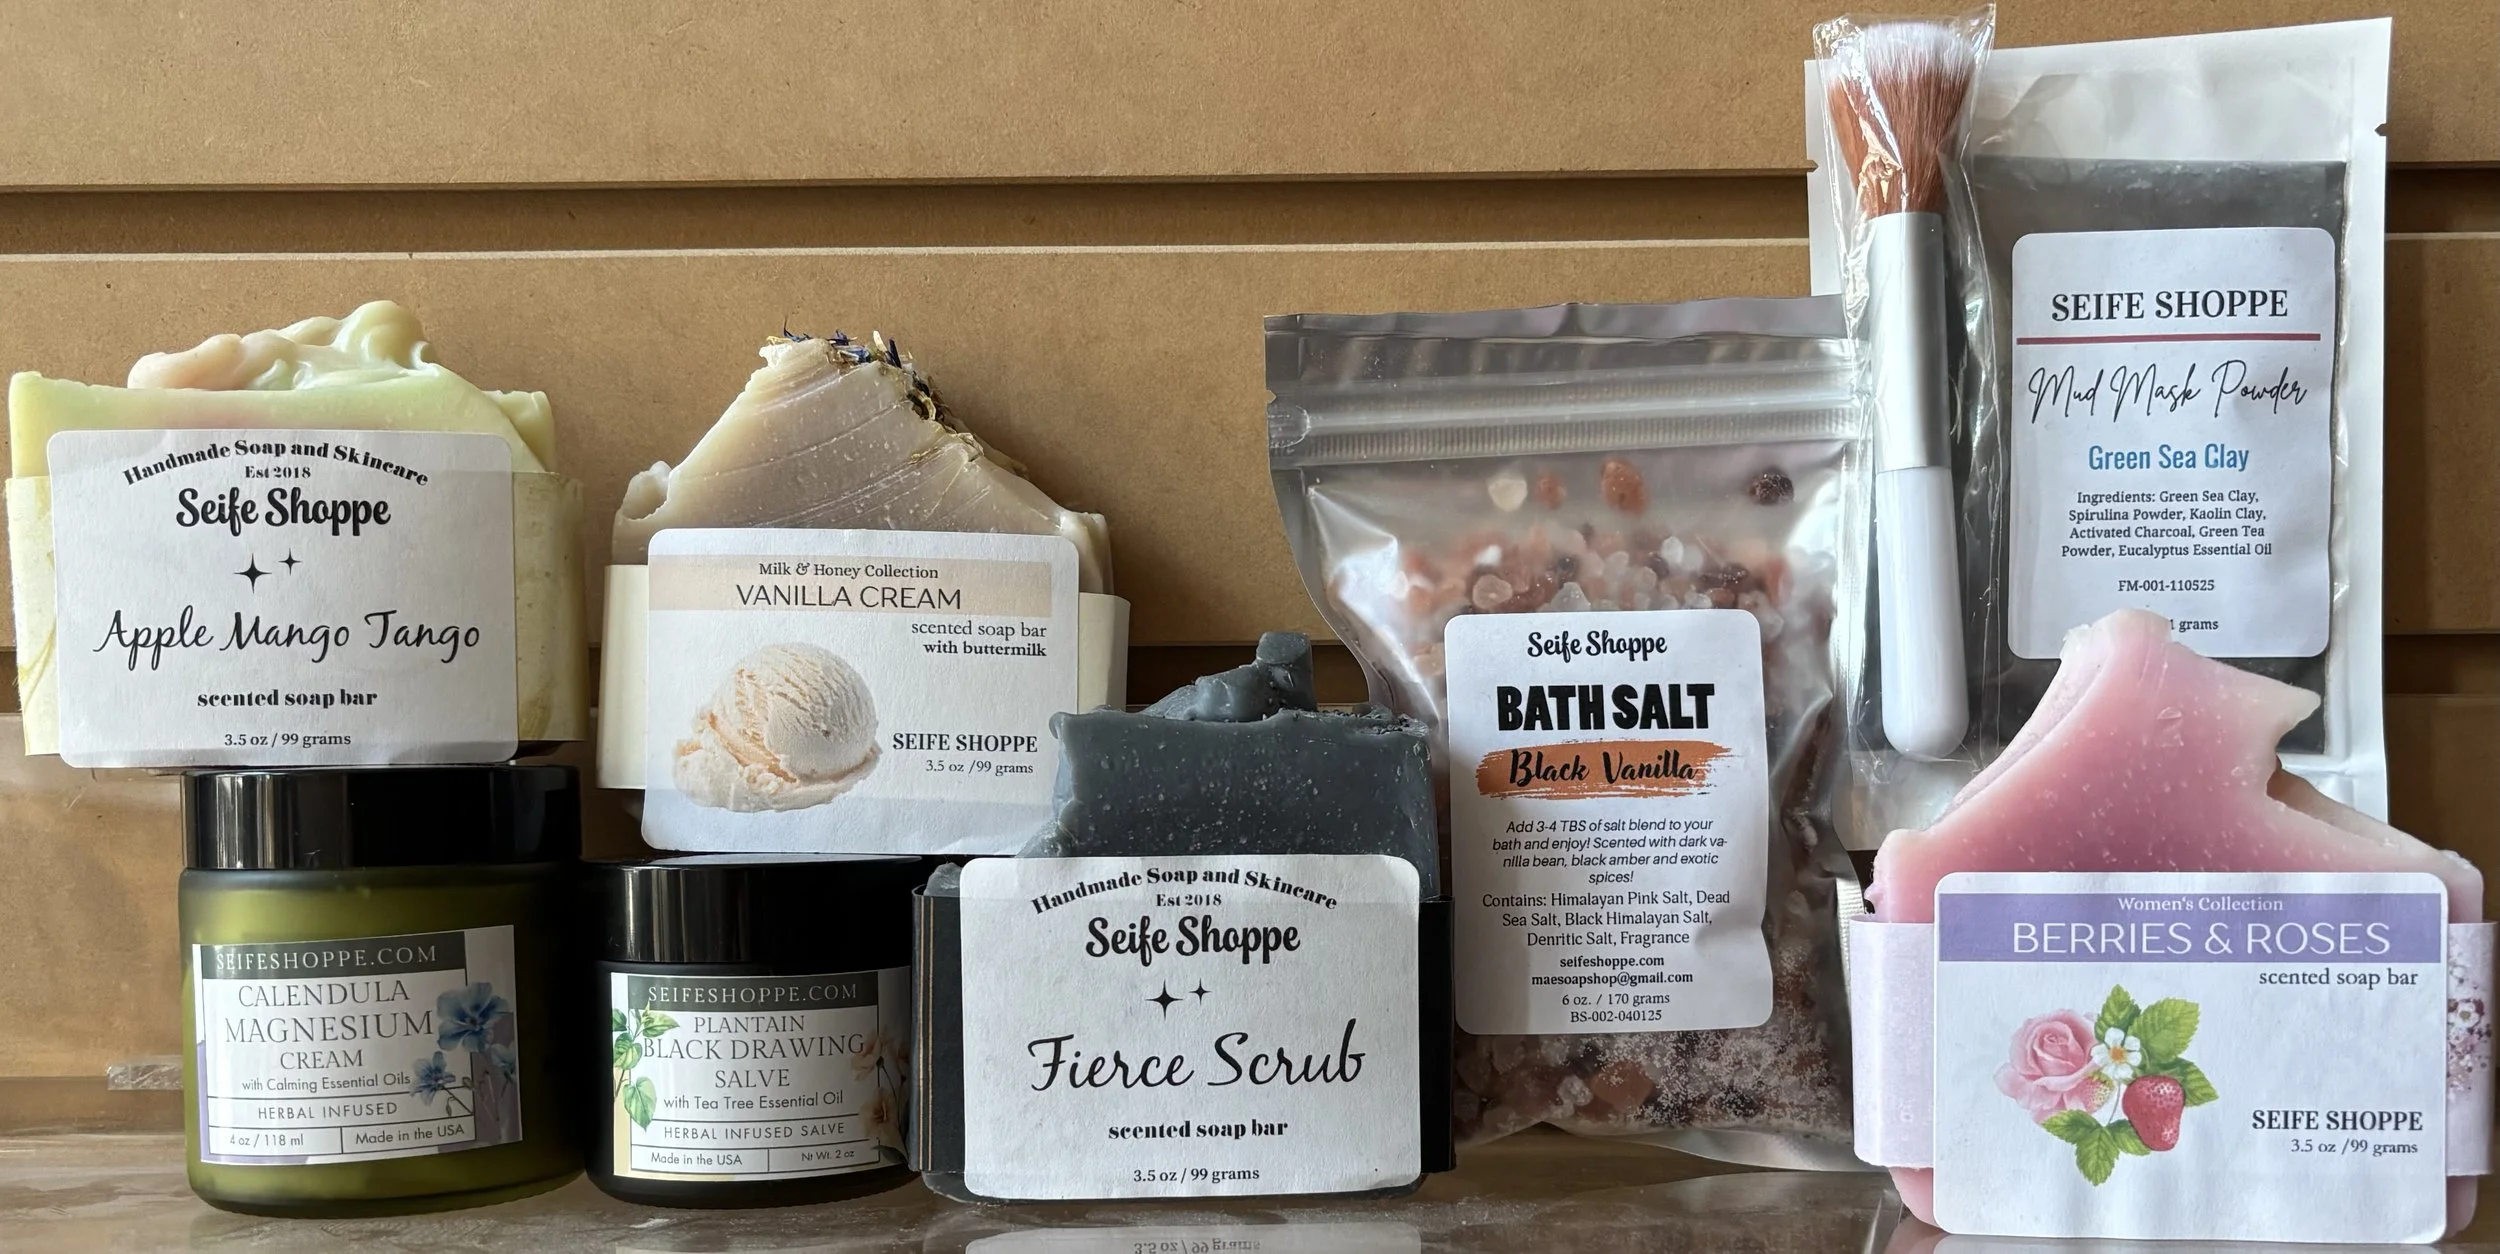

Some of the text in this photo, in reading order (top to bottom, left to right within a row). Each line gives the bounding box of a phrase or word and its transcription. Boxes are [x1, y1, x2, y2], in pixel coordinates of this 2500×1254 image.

[2051, 289, 2288, 322] SEIFE SHOPPE
[2028, 359, 2308, 425] Mud Mask Powder
[123, 439, 429, 486] Handmade Soap and Skincare
[2088, 443, 2250, 473] Green Sea Clay
[245, 465, 311, 479] Est 2018
[2077, 489, 2259, 507] Ingredients: Green Sea Clay,
[175, 486, 392, 537] Seife Shoppe
[2068, 506, 2267, 525] Spirulina Powder, Kaolin Clay,
[2069, 525, 2265, 539] Activated Charcoal, Green Tea
[2061, 542, 2273, 560] Powder, Eucalyptus Essential Oil
[759, 561, 939, 580] Milk & Honey Collection
[2118, 579, 2215, 592] FM-001-110525
[735, 584, 961, 610] VANILLA CREAM
[92, 604, 480, 672] Apple Mango Tango
[911, 619, 1048, 642] scented soap bar
[922, 639, 1047, 657] with buttermilk
[1527, 629, 1668, 664] Seife Shoppe
[197, 688, 378, 710] scented soap bar
[1497, 683, 1715, 731] BATH SALT
[224, 733, 247, 746] 3.5
[250, 735, 269, 746] oz
[281, 733, 299, 746] 99
[302, 735, 352, 749] grams
[892, 732, 1038, 753] SEIFE SHOPPE
[1509, 749, 1698, 787] Black Vanilla
[1506, 818, 1714, 834] Add 3-4 TBS of salt blend to your
[1492, 835, 1728, 853] bath and enjoy! Scented with dark va-
[1503, 852, 1719, 868] nilla bean, black amber and exotic
[1031, 867, 1337, 915] Handmade Soap and Skincare
[1156, 893, 1222, 907] Est 2018
[1482, 890, 1731, 910] Contains: Himalayan Pink Salt, Dead
[2198, 895, 2284, 912] Collection
[1502, 910, 1712, 929] Sea Salt, Black Himalayan Salt,
[1085, 914, 1301, 968] Seife Shoppe
[1527, 930, 1690, 949] Denritic Salt, Fragrance
[2013, 922, 2390, 955] BERRIES & ROSES
[216, 944, 436, 973] SEIFESHOPPE.COM
[1559, 955, 1665, 971] seifeshoppe.com
[1531, 971, 1694, 989] maesoapshop@gmail.com
[2259, 967, 2419, 991] scented soap bar
[238, 979, 410, 1007] CALENDULA
[647, 983, 856, 1004] SEIFESHOPPE.COM
[694, 1014, 805, 1034] PLANTAIN
[1570, 1009, 1662, 1023] BS-002-040125
[225, 1010, 433, 1044] MAGNESIUM
[643, 1033, 865, 1060] BLACK DRAWING
[1027, 1018, 1366, 1092] Fierce Scrub
[279, 1048, 363, 1070] CREAM
[241, 1071, 411, 1094] with Calming Essential Oils
[715, 1068, 790, 1089] SALVE
[663, 1089, 843, 1110] with Tea Tree Essential Oil
[258, 1101, 398, 1120] HERBAL INFUSED
[2252, 1109, 2423, 1131] SEIFE SHOPPE
[664, 1122, 845, 1140] HERBAL INFUSED SALVE
[1108, 1118, 1289, 1140] scented soap bar
[650, 1152, 743, 1166] Made in the USA
